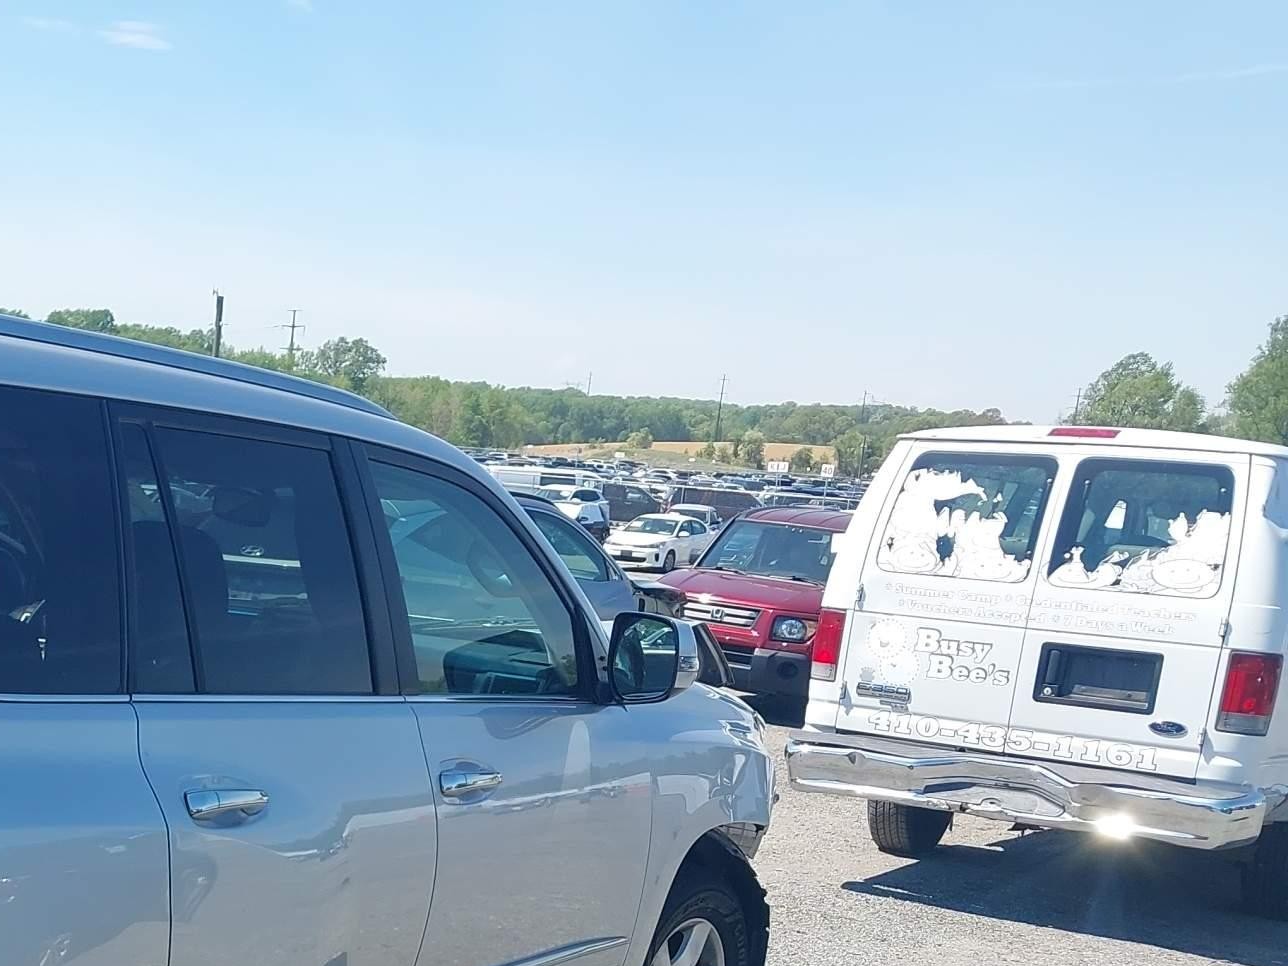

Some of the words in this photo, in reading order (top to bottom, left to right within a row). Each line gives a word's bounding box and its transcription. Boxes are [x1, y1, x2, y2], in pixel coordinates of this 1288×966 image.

[914, 627, 993, 664] Busy
[926, 653, 1011, 687] Bee's
[868, 709, 1158, 772] 410-435-1161
